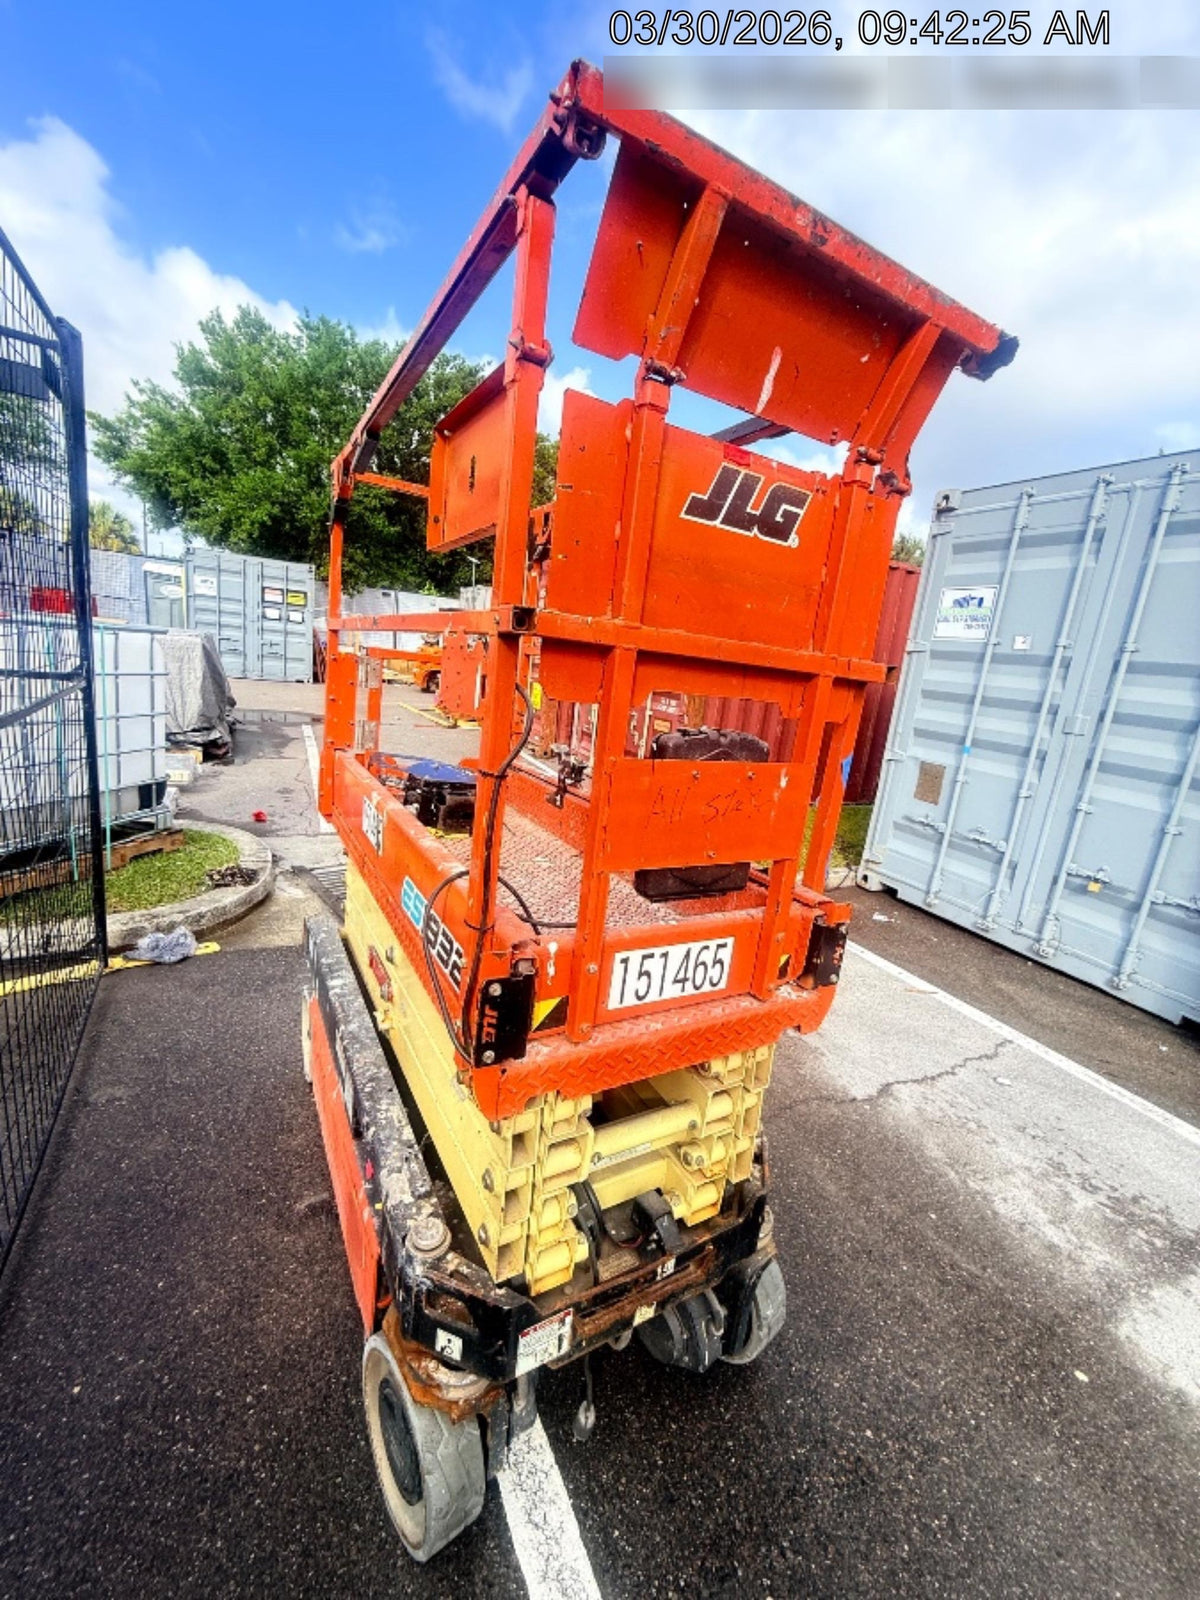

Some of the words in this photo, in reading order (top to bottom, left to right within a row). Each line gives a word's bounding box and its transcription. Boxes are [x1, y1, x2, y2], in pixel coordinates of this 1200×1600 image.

[679, 462, 813, 547] JLG
[618, 942, 728, 1005] 151465
[481, 1003, 499, 1045] JLG
